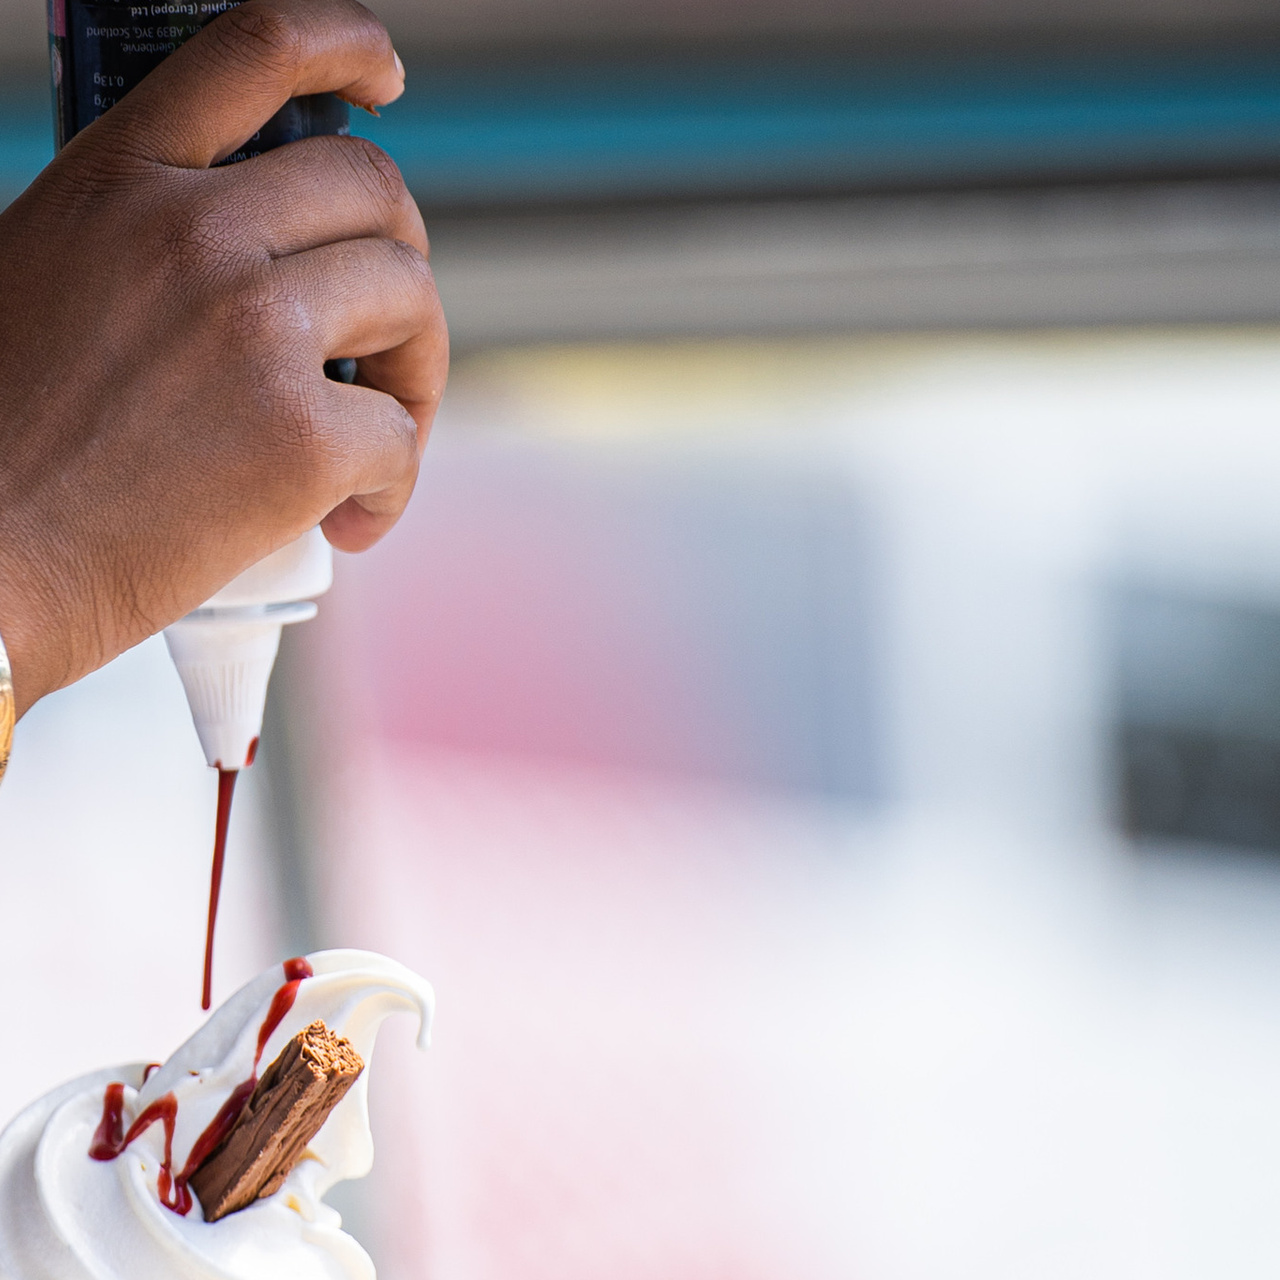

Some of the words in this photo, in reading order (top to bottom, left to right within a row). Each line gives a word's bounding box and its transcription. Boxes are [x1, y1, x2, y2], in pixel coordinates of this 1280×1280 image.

[150, 3, 198, 15] (Europe)
[200, 0, 244, 15] acphie
[86, 26, 130, 39] Scotland
[93, 72, 124, 87] 0.13g
